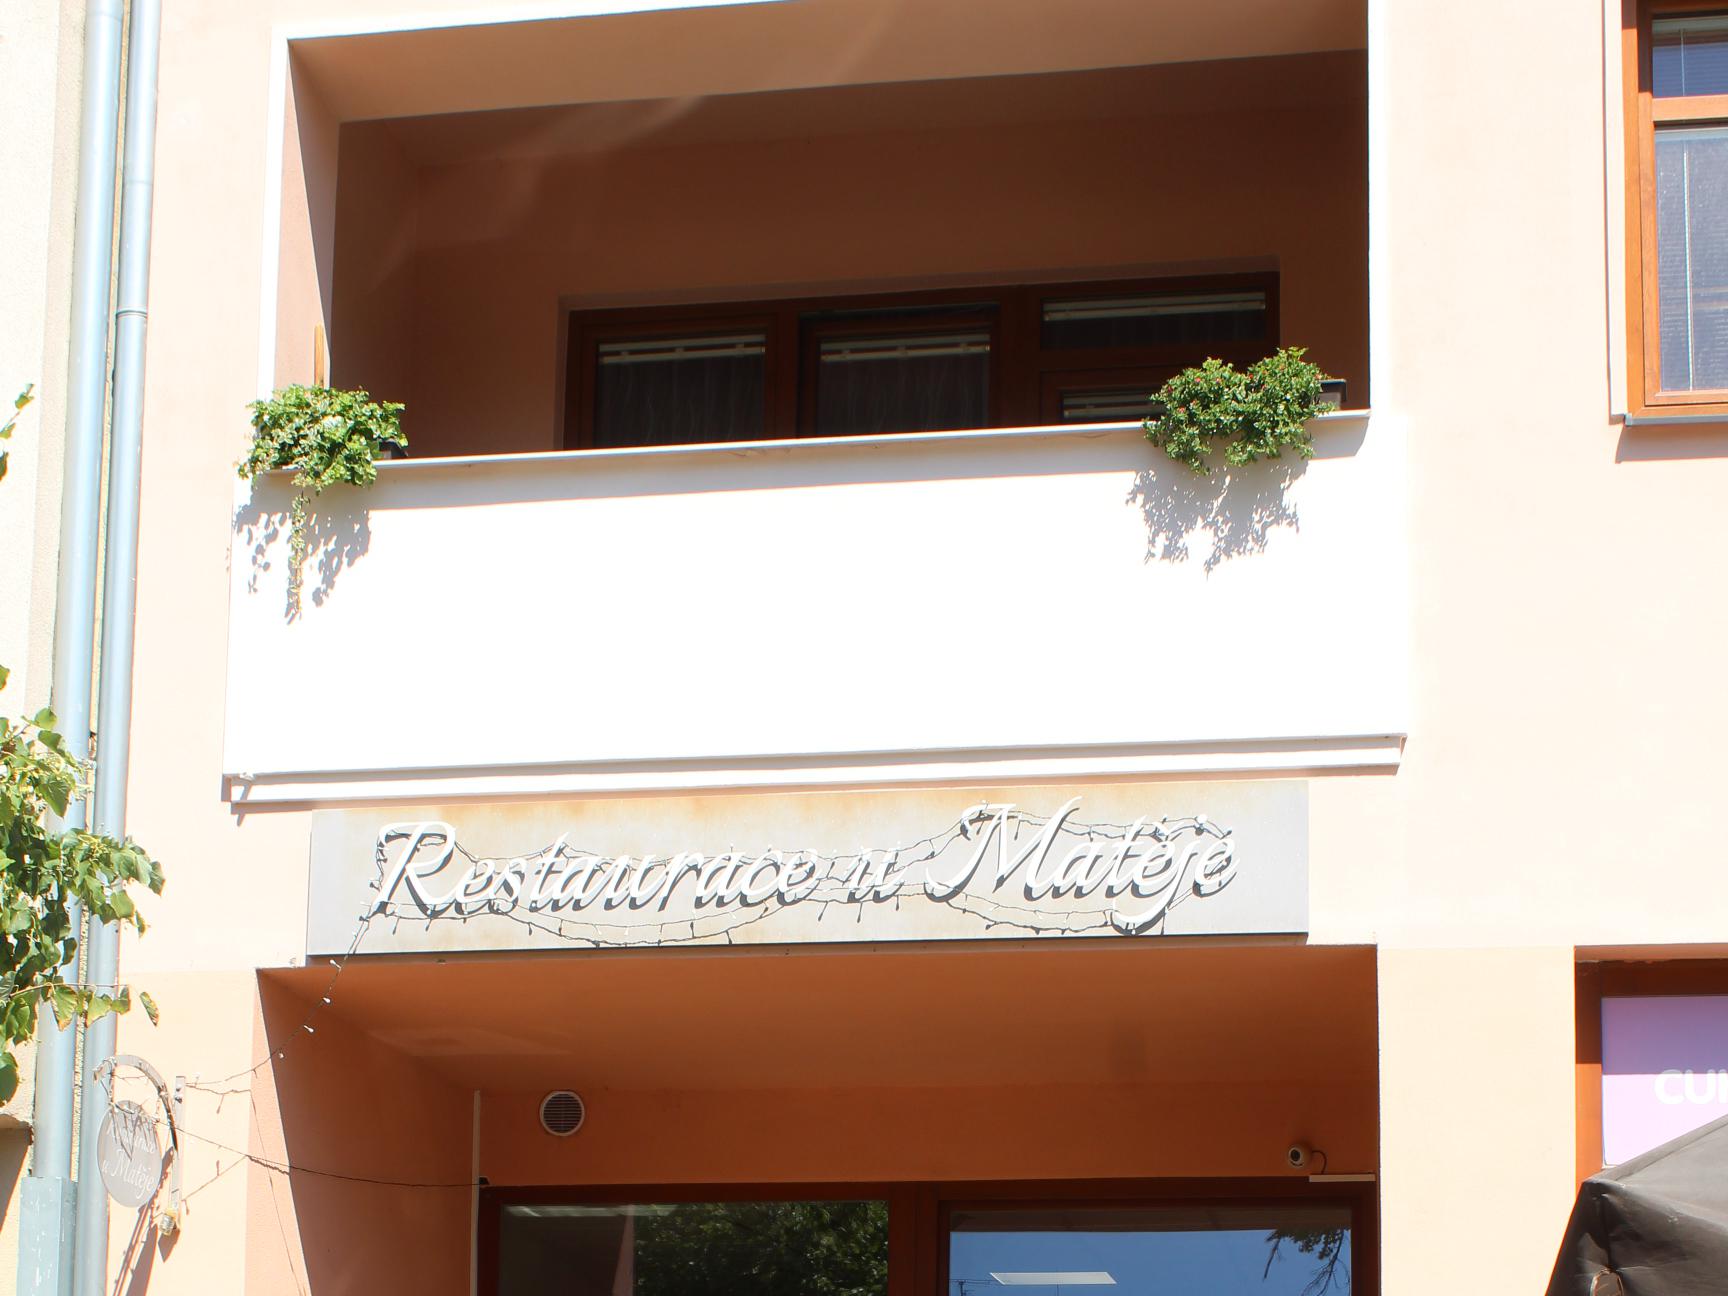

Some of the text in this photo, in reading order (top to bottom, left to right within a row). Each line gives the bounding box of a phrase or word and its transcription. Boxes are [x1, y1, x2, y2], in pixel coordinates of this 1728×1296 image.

[374, 796, 1239, 931] Restaurace u Matěje
